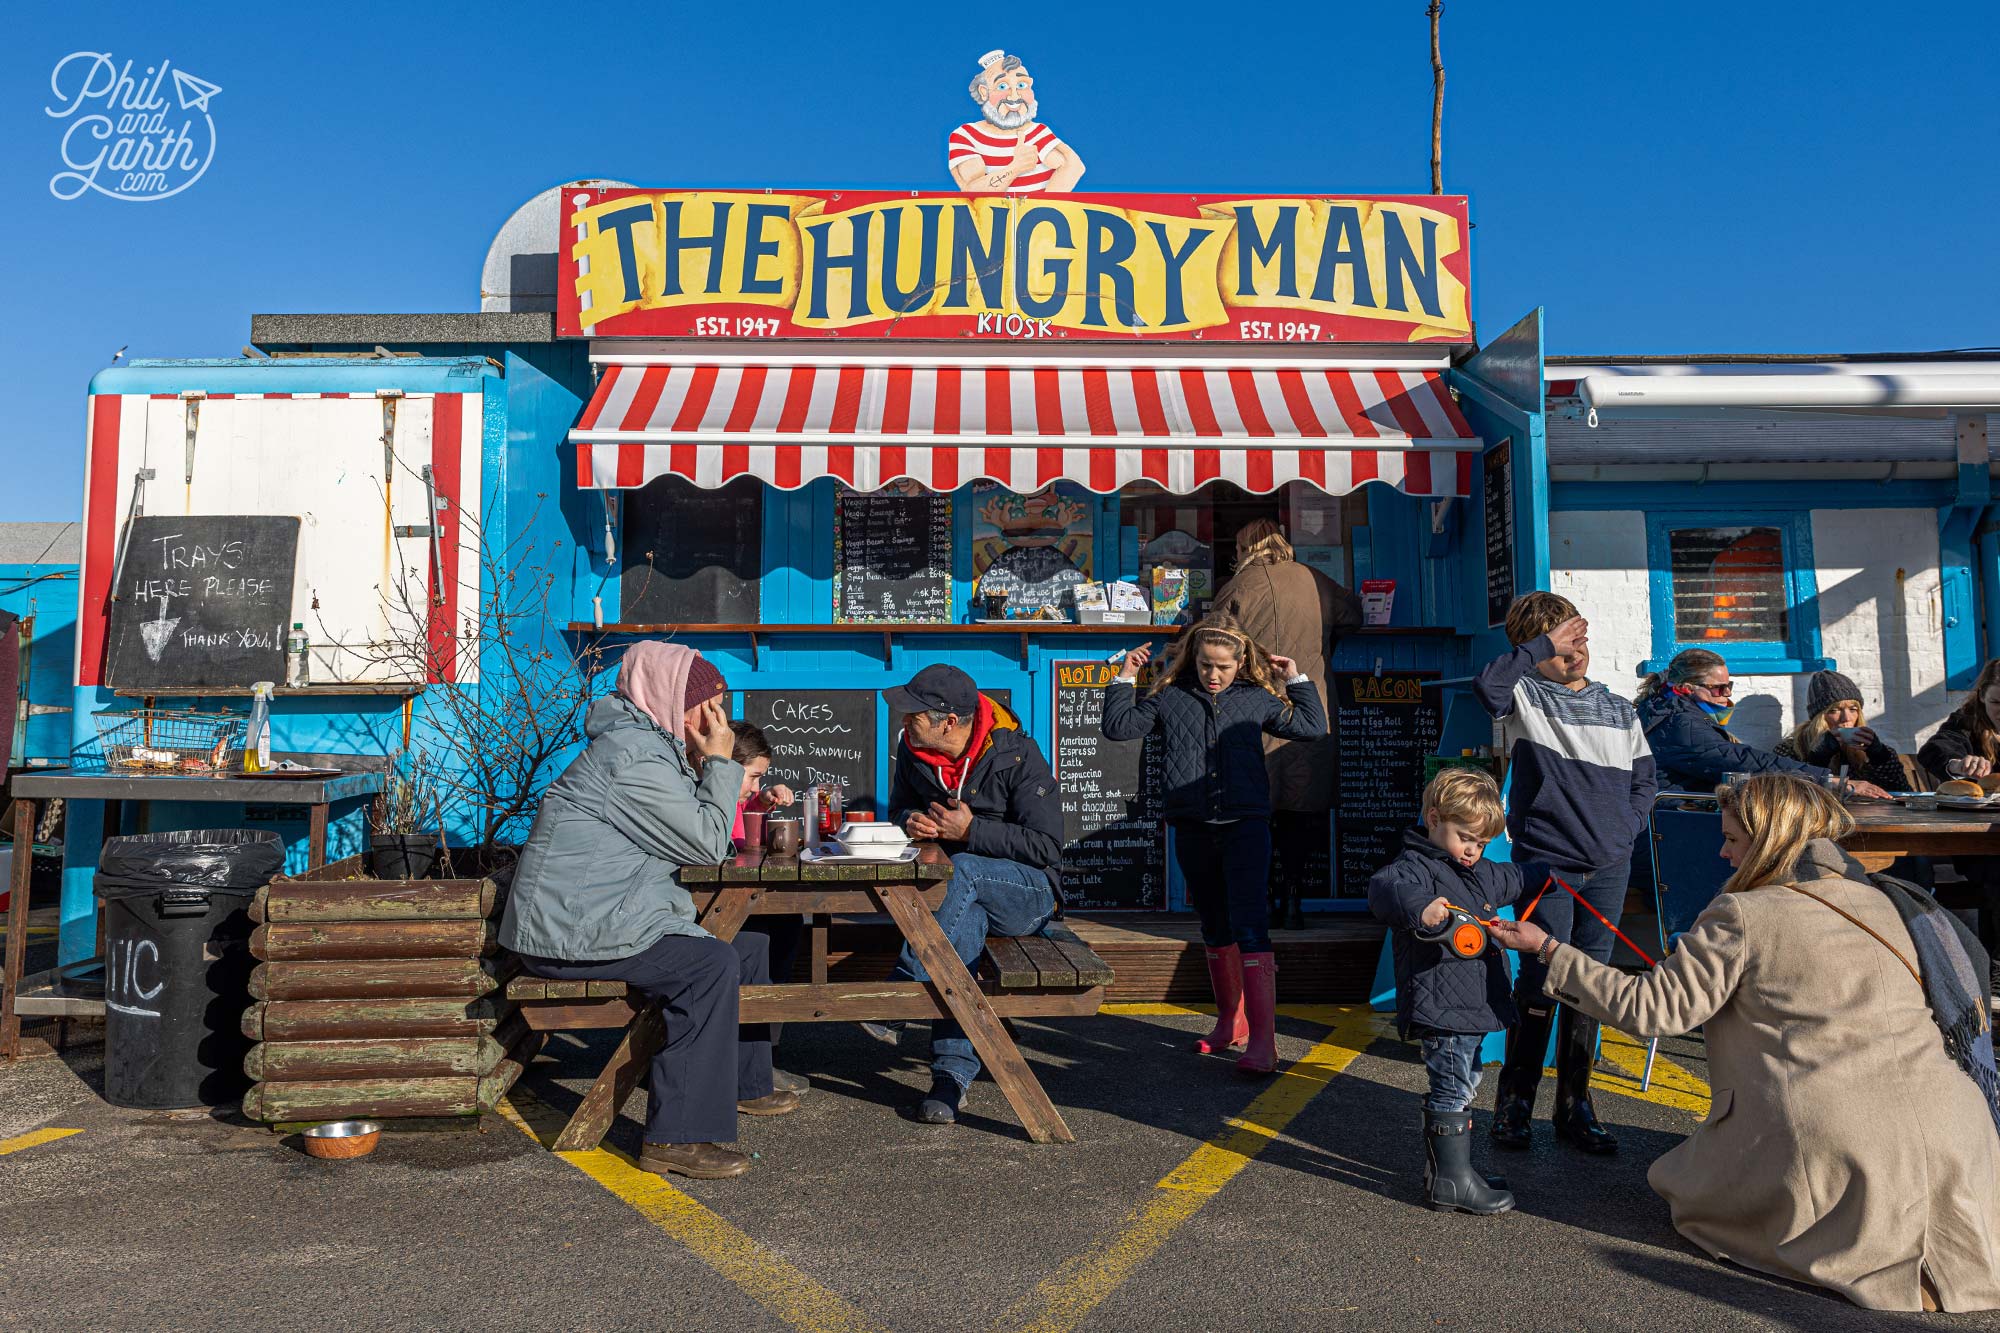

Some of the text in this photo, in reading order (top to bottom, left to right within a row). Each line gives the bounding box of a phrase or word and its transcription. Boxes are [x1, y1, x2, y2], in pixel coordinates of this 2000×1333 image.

[599, 201, 1446, 328] THE HUNGRY MAN
[695, 317, 780, 336] EST. 1947
[977, 312, 1053, 338] KIOSK
[1240, 321, 1321, 341] EST. 1947
[152, 534, 243, 570] TRAYS
[847, 571, 864, 583] Spicy
[866, 571, 882, 580] Bean
[135, 575, 273, 603] HERE PLEASE
[906, 599, 922, 608] Vegan
[179, 627, 230, 648] THANK
[1060, 665, 1095, 684] HOT
[1352, 677, 1422, 697] BACON
[1060, 690, 1076, 703] Mug
[1080, 688, 1088, 703] of
[771, 699, 834, 721] CAKES
[1060, 700, 1100, 717] Mug of Earl
[1060, 716, 1073, 729] Mug
[1075, 715, 1081, 727] of
[1369, 717, 1383, 728] Egg
[1060, 736, 1097, 746] Americano
[808, 742, 862, 765] SANDWICH
[1060, 747, 1096, 757] Espresso
[1060, 757, 1083, 767] Latte
[764, 766, 851, 787] EMON DRIZZLE
[1060, 769, 1102, 782] Cappuccino
[1061, 780, 1100, 793] Flat White
[1083, 791, 1102, 799] extra
[1062, 801, 1118, 812] Hot chocolate
[1081, 812, 1128, 822] with cream
[1082, 820, 1157, 831] with marshmallows
[1063, 838, 1081, 849] with
[1083, 840, 1104, 848] cream
[1113, 837, 1155, 848] marshmallows
[1061, 873, 1080, 885] Chai
